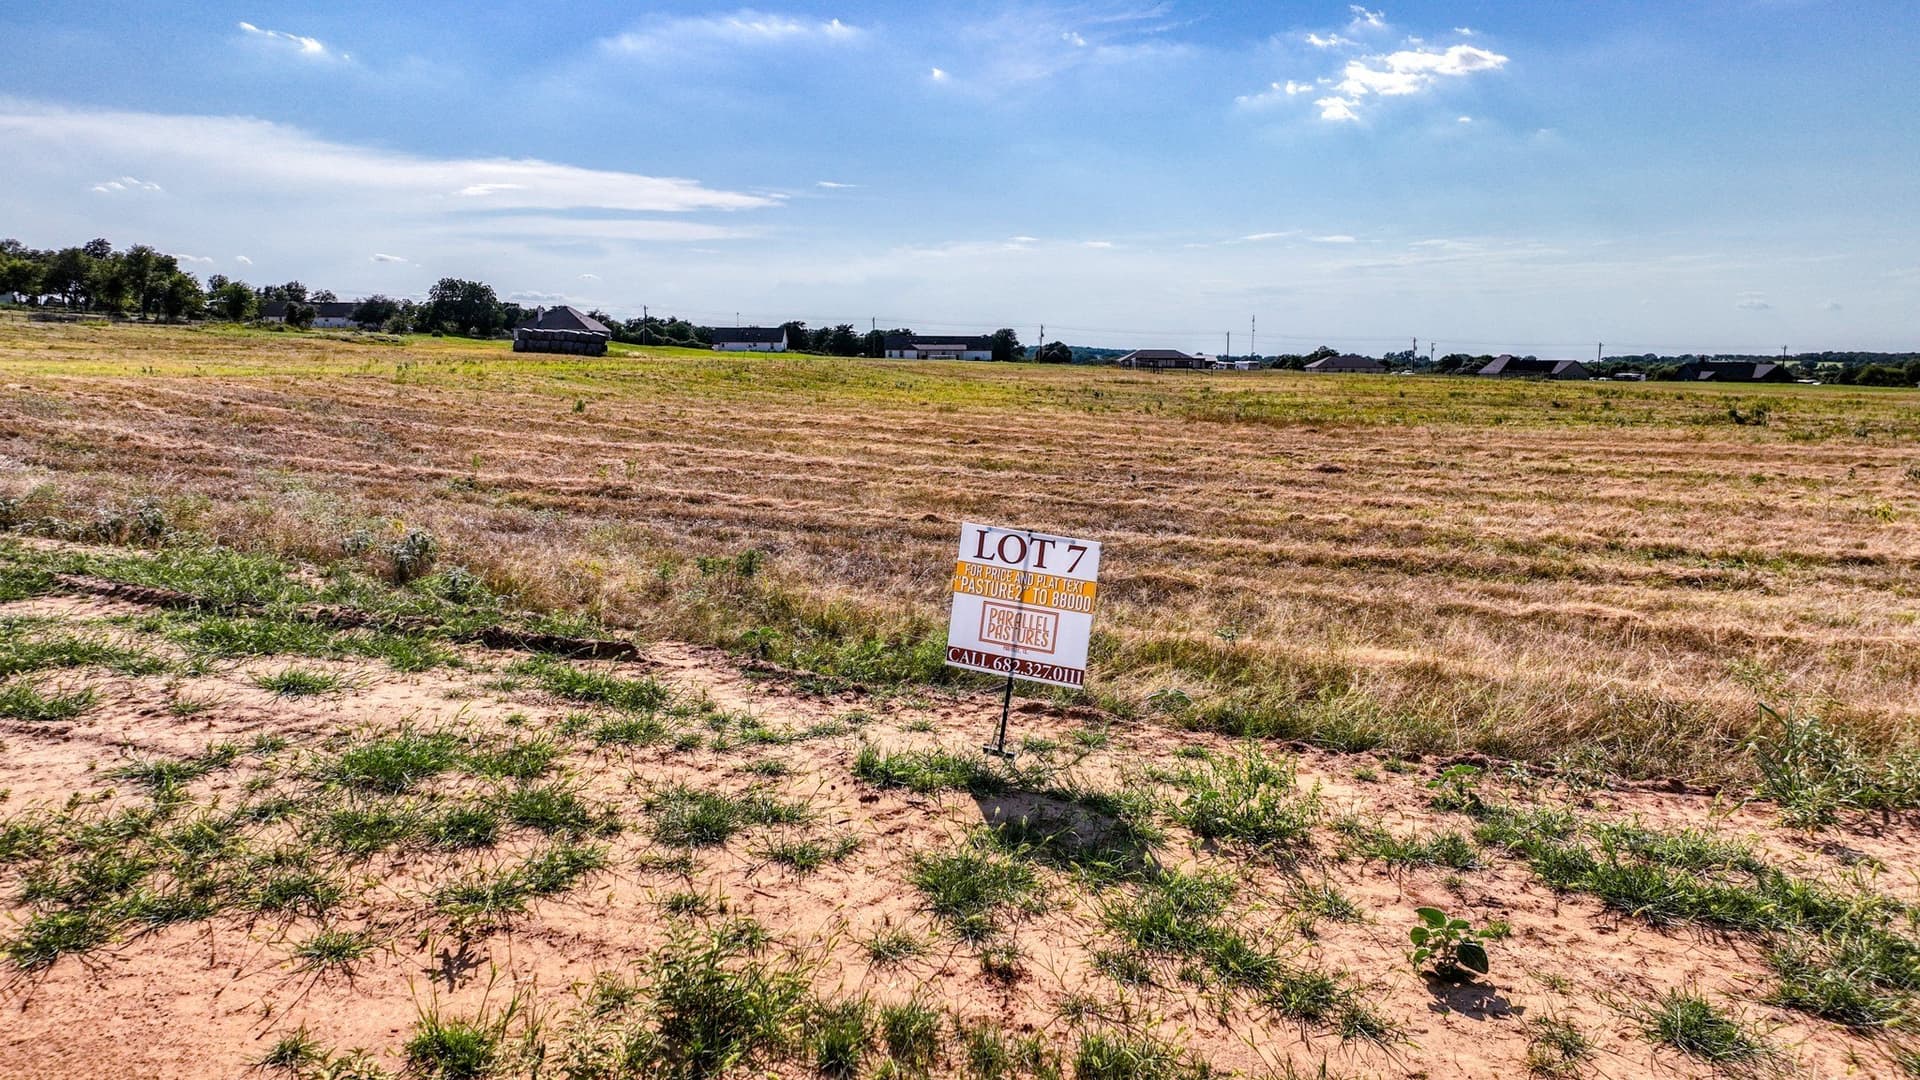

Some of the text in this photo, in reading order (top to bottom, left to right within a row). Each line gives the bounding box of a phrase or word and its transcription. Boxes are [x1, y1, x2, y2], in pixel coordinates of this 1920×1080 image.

[973, 530, 1087, 573] LOT 7
[965, 564, 1085, 593] FOR PRICE AND PLAT TEXT
[1033, 588, 1047, 605] TO
[1052, 592, 1091, 611] 88000
[990, 608, 1049, 632] PARALLEL
[987, 623, 1049, 648] PASTURES
[948, 648, 990, 668] CALL
